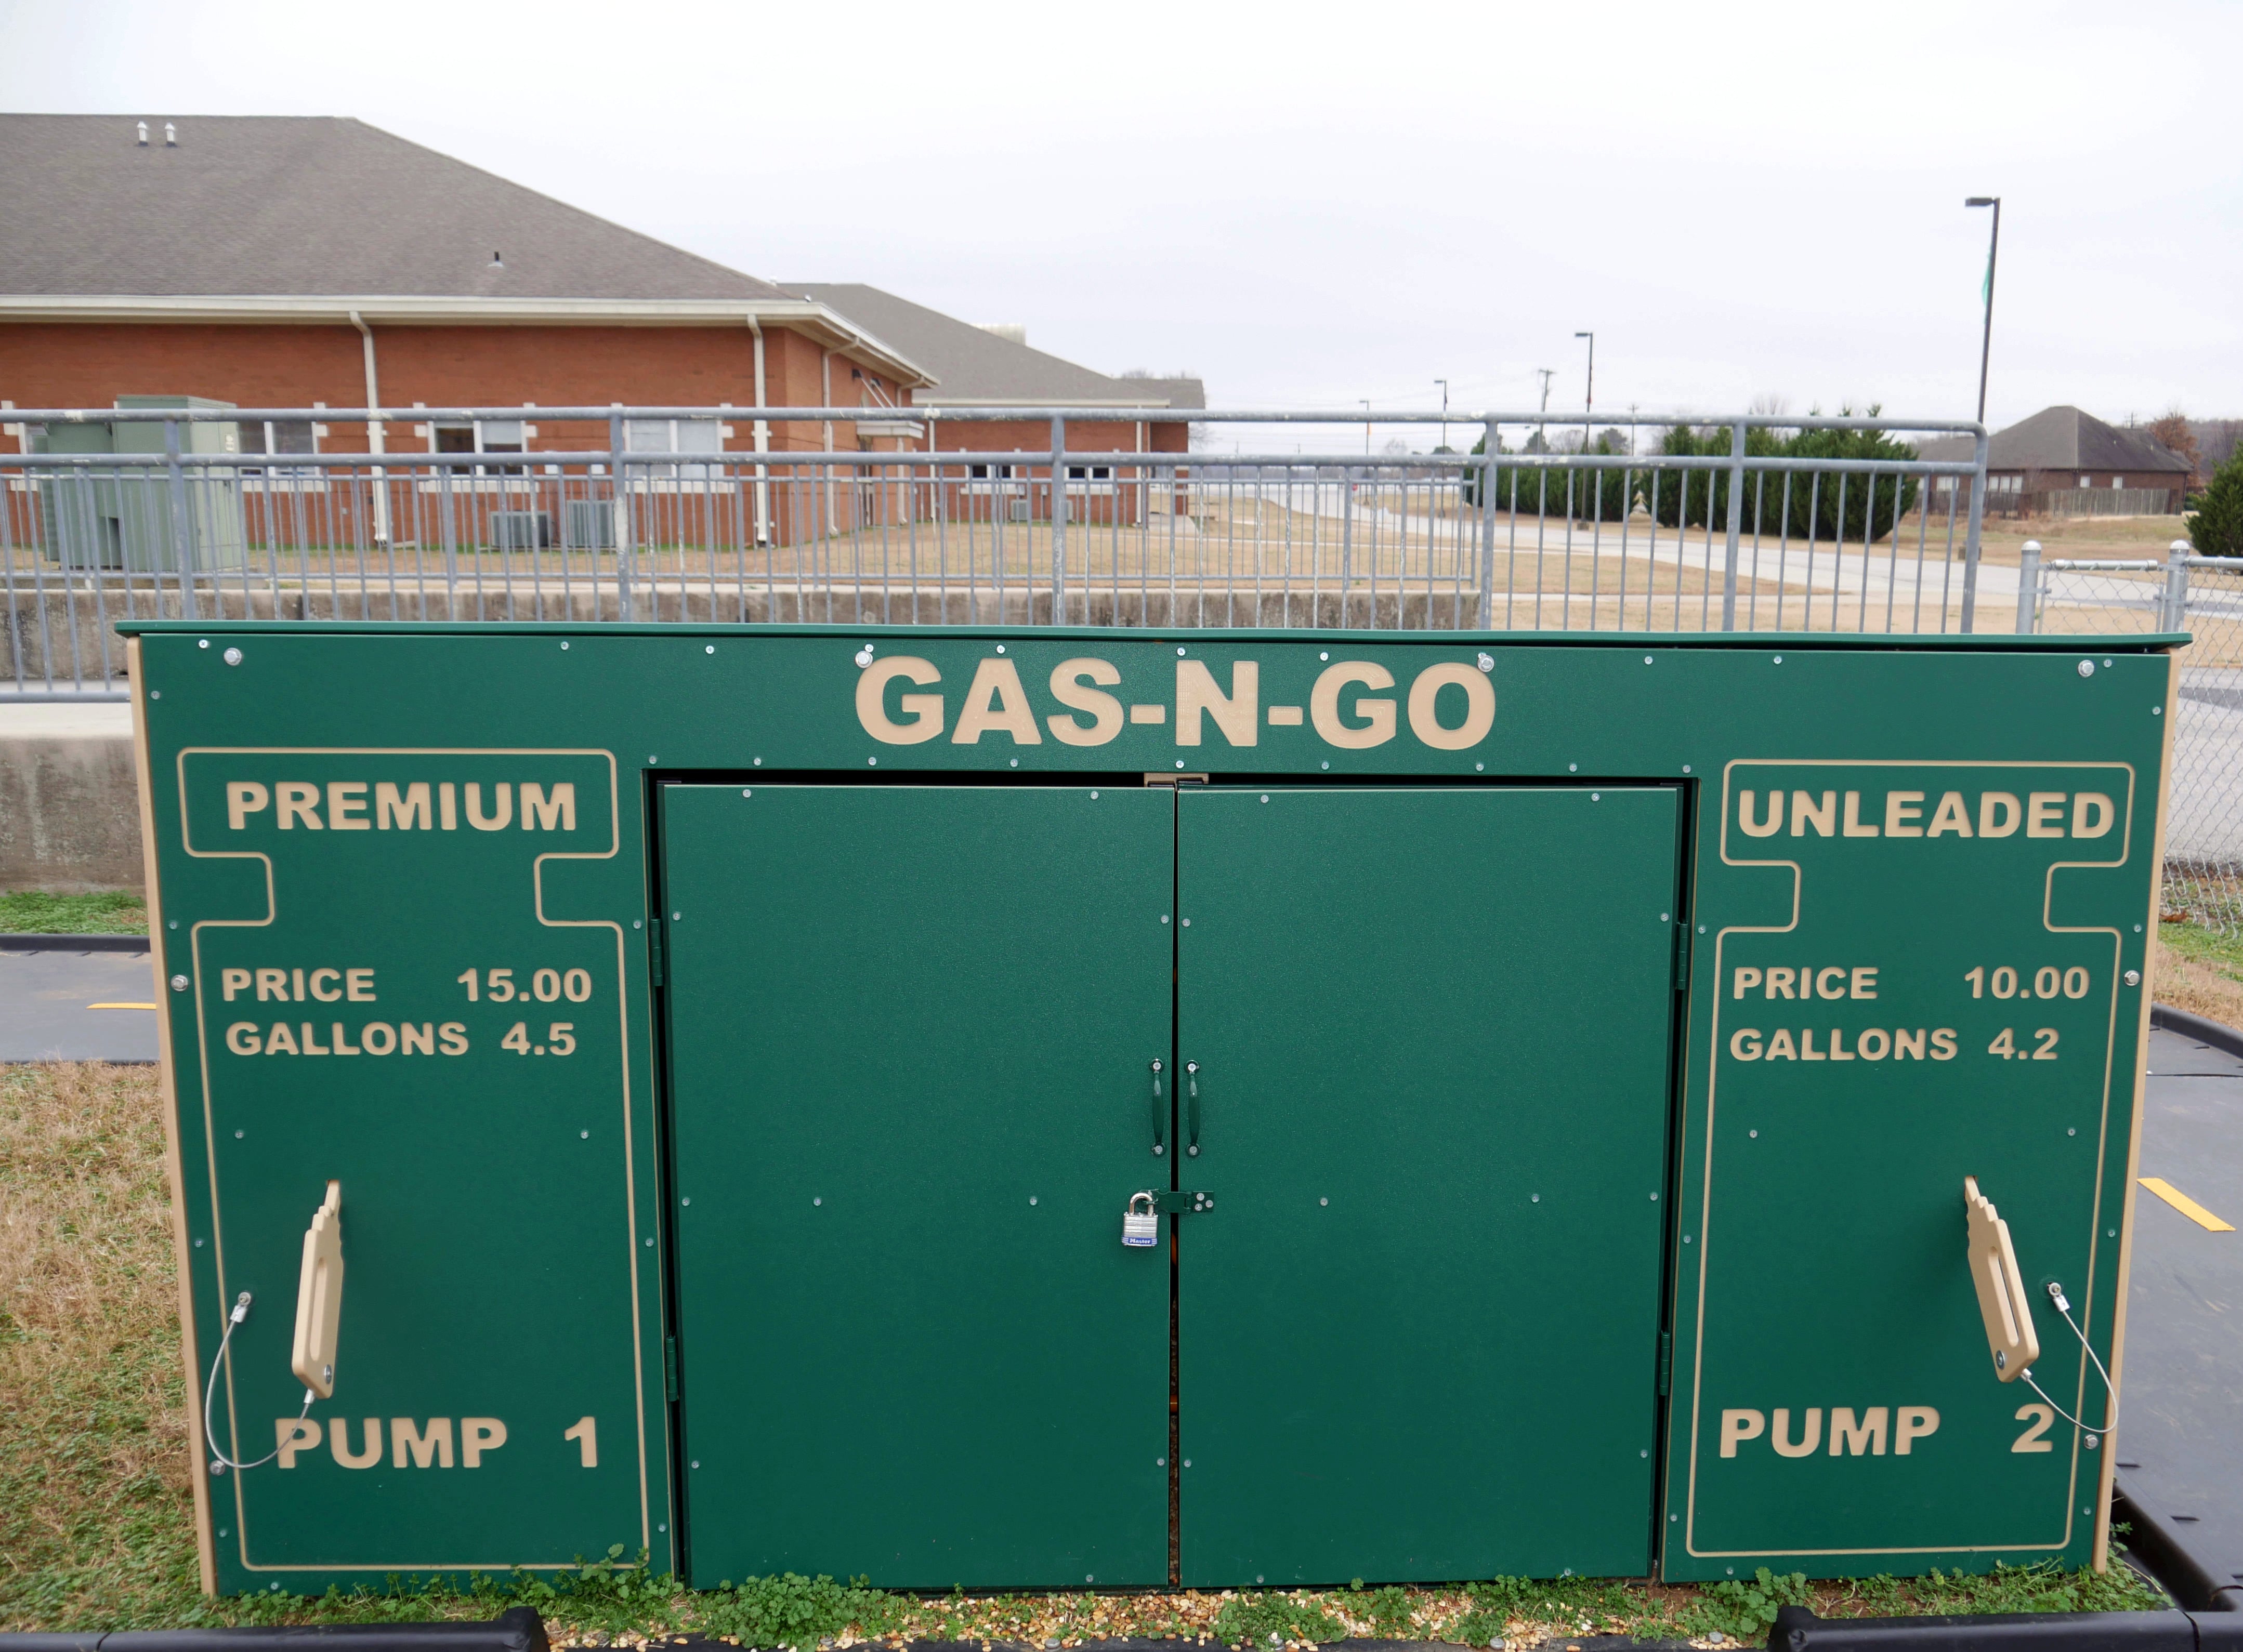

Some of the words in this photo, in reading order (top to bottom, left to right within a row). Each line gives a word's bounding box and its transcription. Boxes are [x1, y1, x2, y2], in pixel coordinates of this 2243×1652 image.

[855, 655, 1496, 750] GAS-N-GO
[227, 782, 576, 831] PREMIUM
[1739, 789, 2115, 838] UNLEADED
[222, 968, 376, 1002] PRICE
[457, 968, 592, 1002] 15.00
[1734, 967, 1879, 999] PRICE
[1964, 966, 2090, 999] 10.00
[226, 1021, 469, 1056] GALLONS
[501, 1022, 576, 1055] 4.5
[1729, 1027, 1958, 1061] GALLONS
[1988, 1027, 2059, 1060] 4.2
[276, 1417, 507, 1469] PUMP
[565, 1416, 597, 1468] 1
[1720, 1406, 1940, 1458] PUMP
[2011, 1403, 2054, 1453] 2
